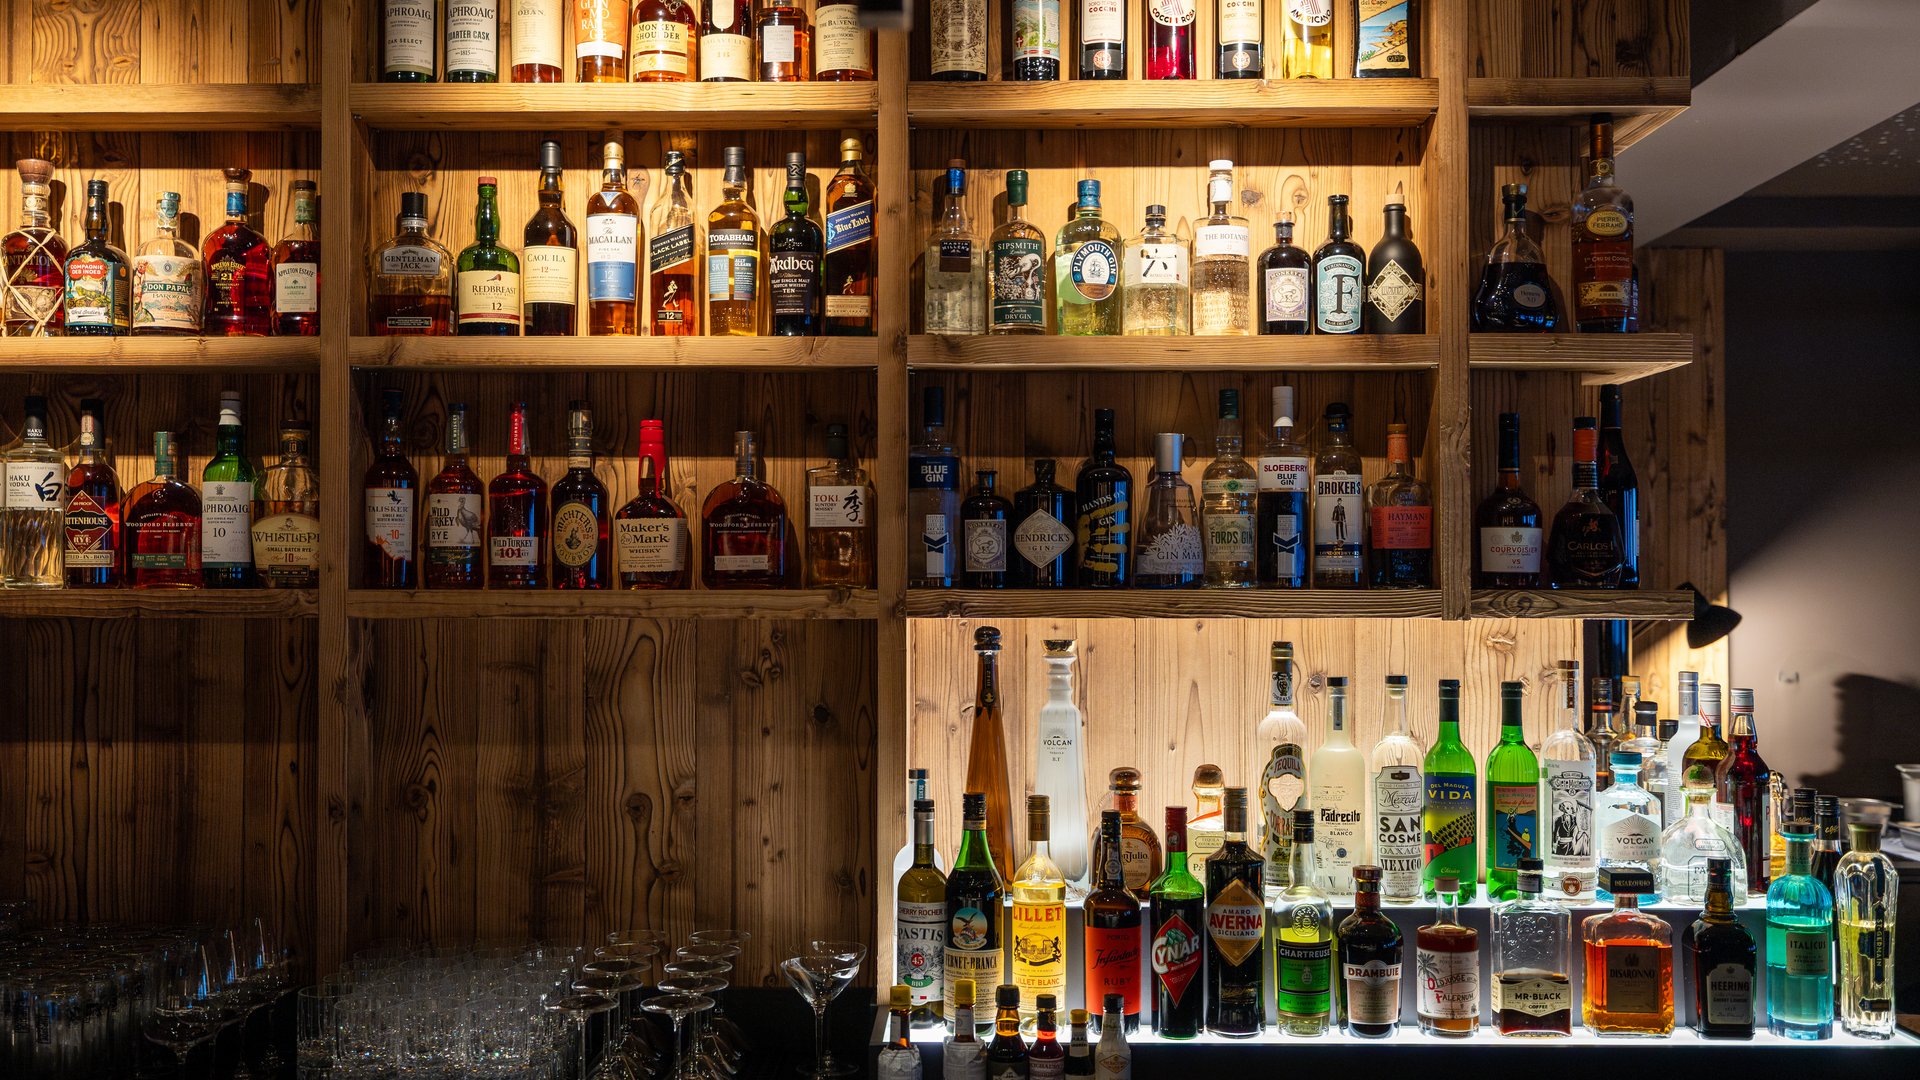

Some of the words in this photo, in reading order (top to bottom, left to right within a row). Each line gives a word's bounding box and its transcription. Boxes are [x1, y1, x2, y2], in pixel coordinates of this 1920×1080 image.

[386, 7, 432, 20] APHROAIG
[447, 7, 494, 19] APHROAIG
[473, 30, 490, 41] CASK
[589, 236, 632, 244] MACALLAN
[528, 253, 549, 262] CAOL
[552, 254, 566, 262] ILA
[1073, 244, 1111, 272] PLYMOUTH
[1109, 257, 1117, 275] GIN
[605, 271, 614, 280] 12
[473, 285, 517, 294] REDBREAST
[1332, 274, 1359, 314] F
[492, 302, 502, 310] 12
[666, 312, 675, 320] 12
[920, 465, 948, 474] BLUE
[1264, 465, 1307, 473] SLOEBERRY
[925, 474, 944, 482] GIN
[1082, 494, 1112, 512] HANDS
[431, 507, 449, 517] WILD
[1099, 515, 1117, 526] GIN
[213, 527, 226, 538] 10
[620, 523, 670, 533] Maker's
[74, 535, 91, 544] RYE
[253, 531, 320, 543] WHISTLEPI
[391, 529, 400, 540] 10
[431, 531, 448, 540] RYE
[633, 534, 670, 544] Mark
[1016, 533, 1069, 543] HENDRICK'S
[1211, 531, 1238, 544] FORDS
[1241, 531, 1253, 544] GIN
[508, 538, 533, 548] TURKEY
[1567, 542, 1609, 551] CARLOS
[285, 553, 293, 562] 10
[500, 548, 522, 558] 101
[1157, 551, 1178, 560] GIN
[1428, 789, 1472, 800] VIDA
[1321, 808, 1361, 822] Padrecito
[1379, 816, 1420, 832] SAN
[1379, 833, 1420, 843] COSME
[1616, 837, 1654, 845] VOLCAN
[1381, 858, 1421, 871] MEXICO
[919, 908, 943, 916] ROCHER
[1013, 907, 1062, 922] LILLET
[1209, 913, 1263, 930] AVERNA
[898, 928, 944, 941] PASTIS
[1152, 934, 1200, 974] CYNAR
[1279, 948, 1330, 959] CHARTREUSE
[912, 957, 924, 966] 45
[1348, 967, 1399, 978] DRAMBUIE
[1038, 978, 1060, 986] BLANC
[1104, 977, 1132, 986] RUBY
[1711, 981, 1750, 991] HEERING
